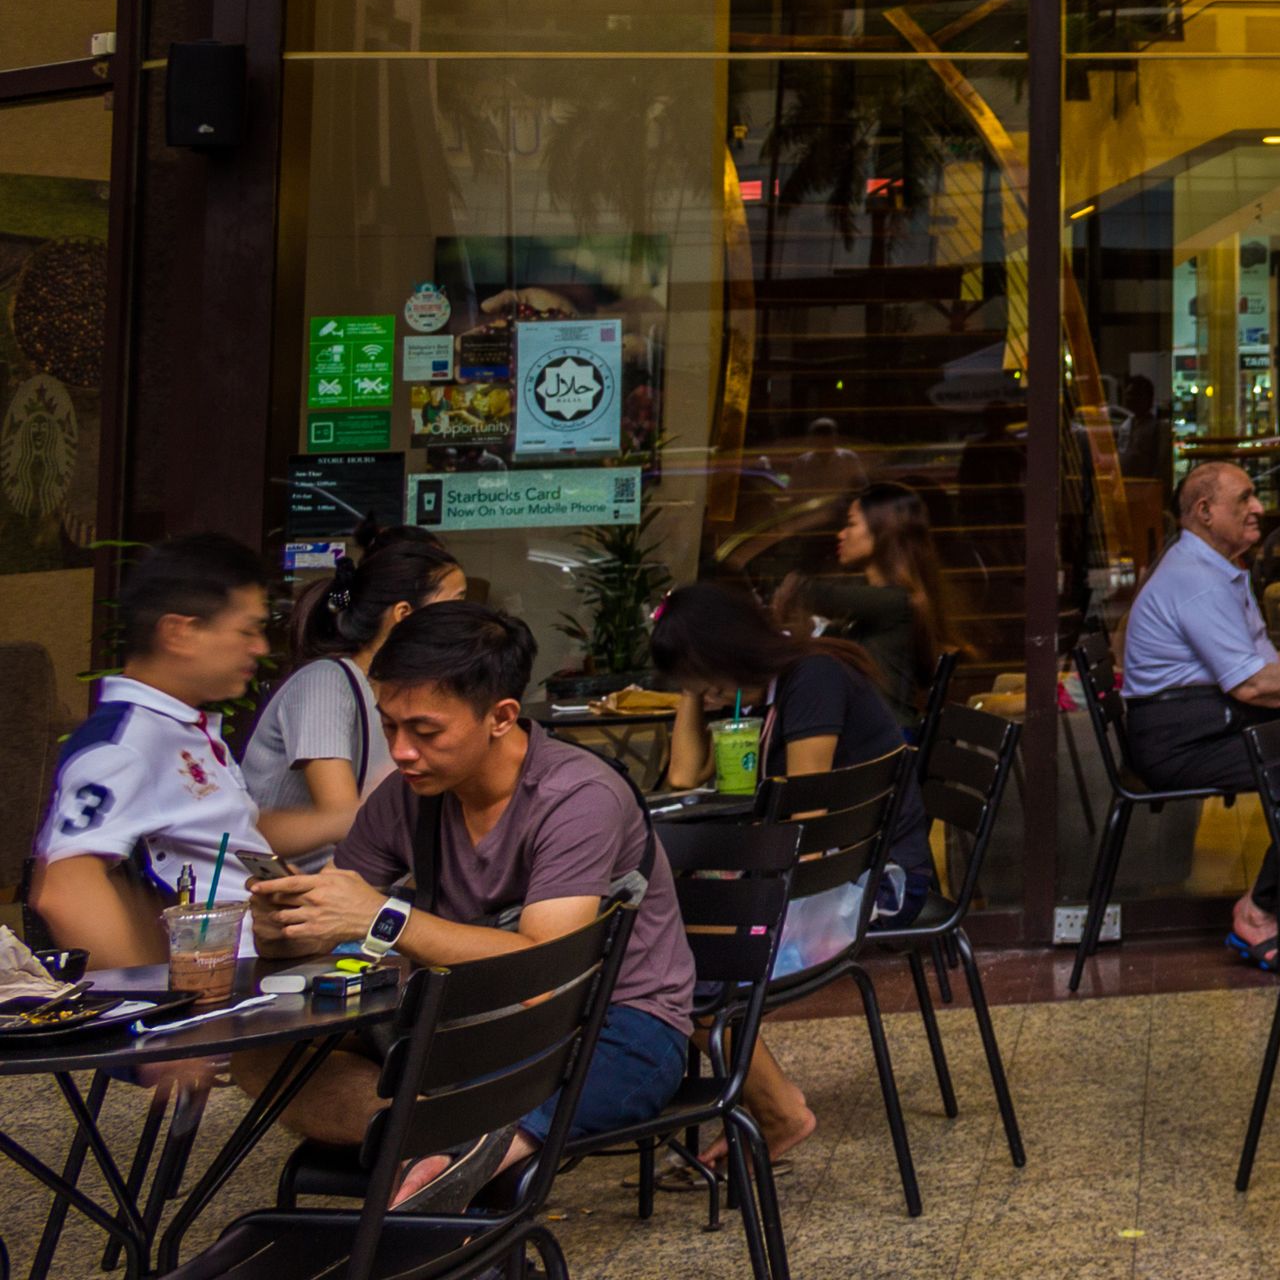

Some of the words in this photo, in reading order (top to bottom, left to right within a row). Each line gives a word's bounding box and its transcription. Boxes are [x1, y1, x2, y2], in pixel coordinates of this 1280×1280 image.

[431, 419, 511, 438] Opportunity
[447, 488, 520, 504] Starbucks
[525, 486, 561, 501] Card
[447, 507, 475, 518] Now
[479, 505, 496, 516] On
[499, 504, 525, 515] Your
[528, 502, 568, 515] Mobile
[571, 502, 607, 513] Phone
[60, 782, 116, 837] 3
